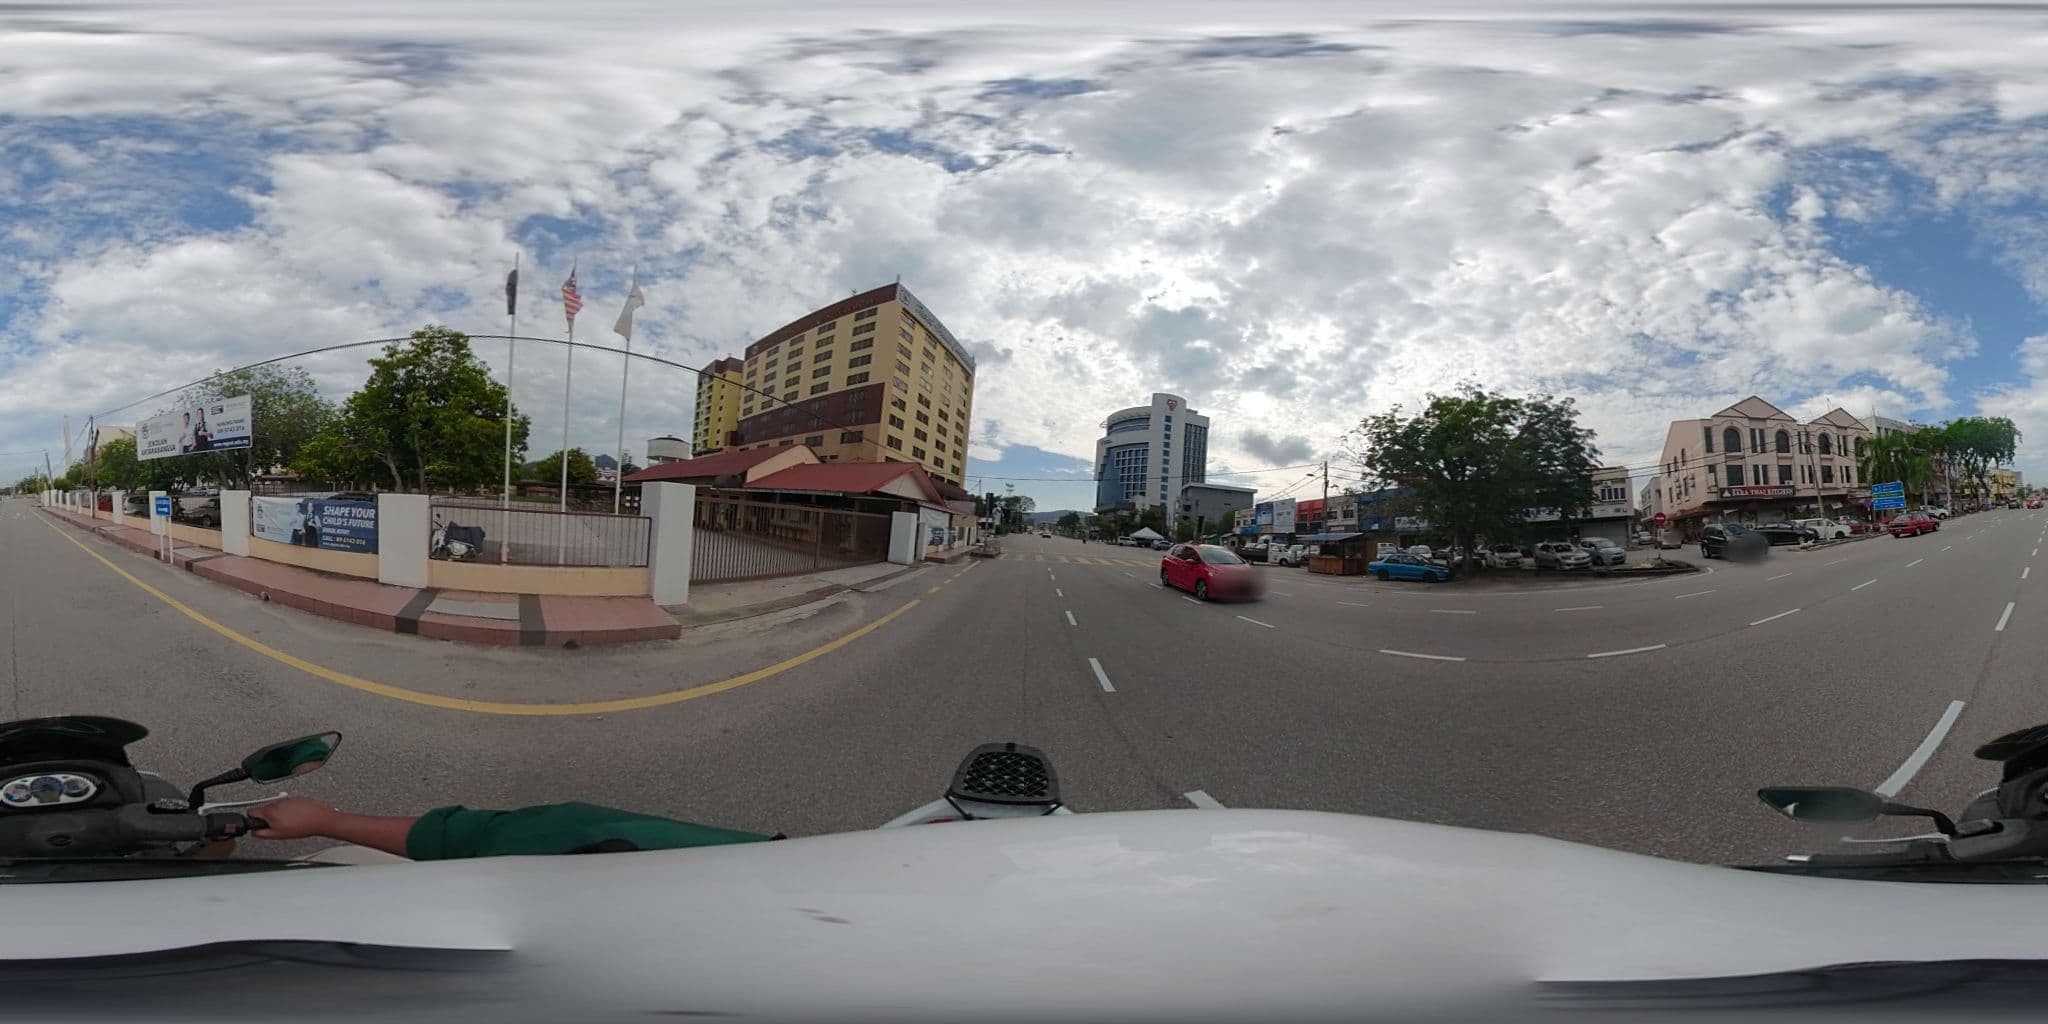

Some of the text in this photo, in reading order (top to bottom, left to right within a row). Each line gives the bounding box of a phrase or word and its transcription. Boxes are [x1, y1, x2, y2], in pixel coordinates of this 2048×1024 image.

[323, 505, 376, 519] SHAPE YOUR
[323, 516, 375, 529] CHILD'S FUTURE
